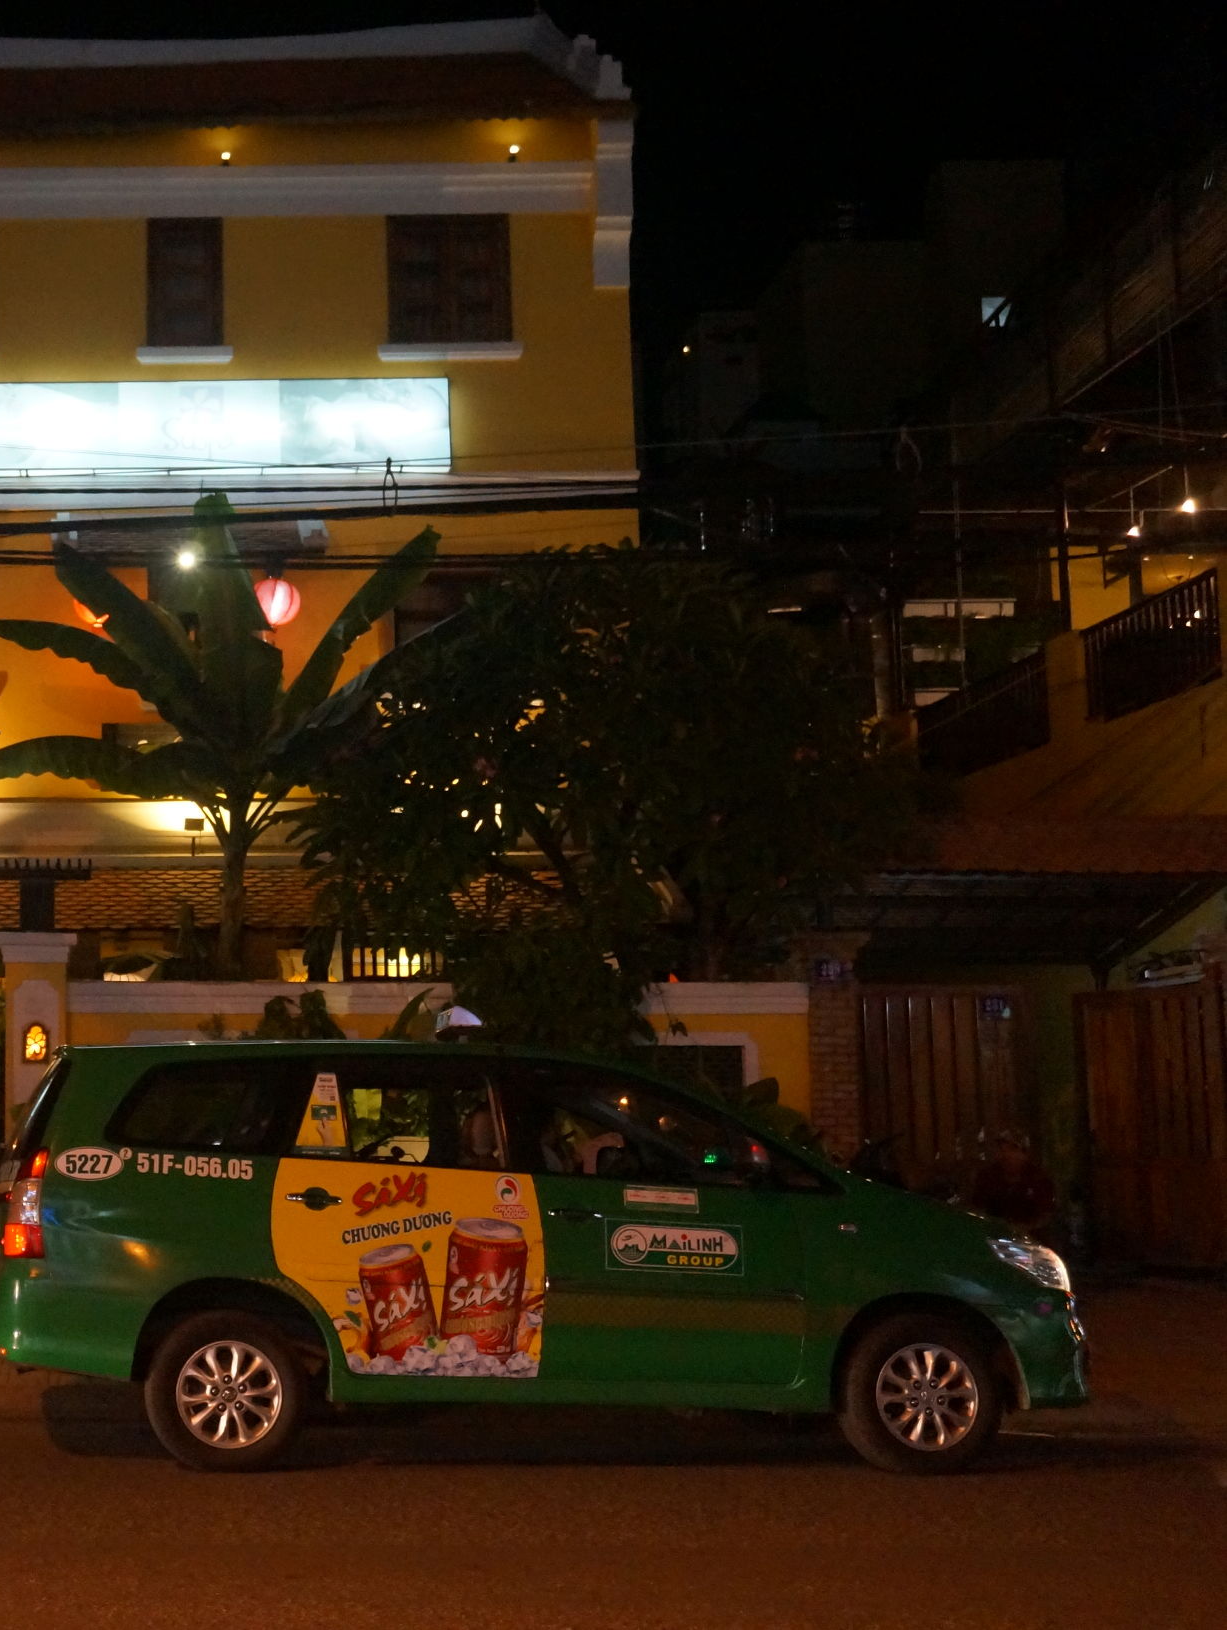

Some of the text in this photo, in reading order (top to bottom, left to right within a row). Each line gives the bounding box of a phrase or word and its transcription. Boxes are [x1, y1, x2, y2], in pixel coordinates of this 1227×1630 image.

[65, 1154, 113, 1174] 5227
[136, 1152, 254, 1180] 51F-056.05
[666, 1254, 724, 1267] GROUP
